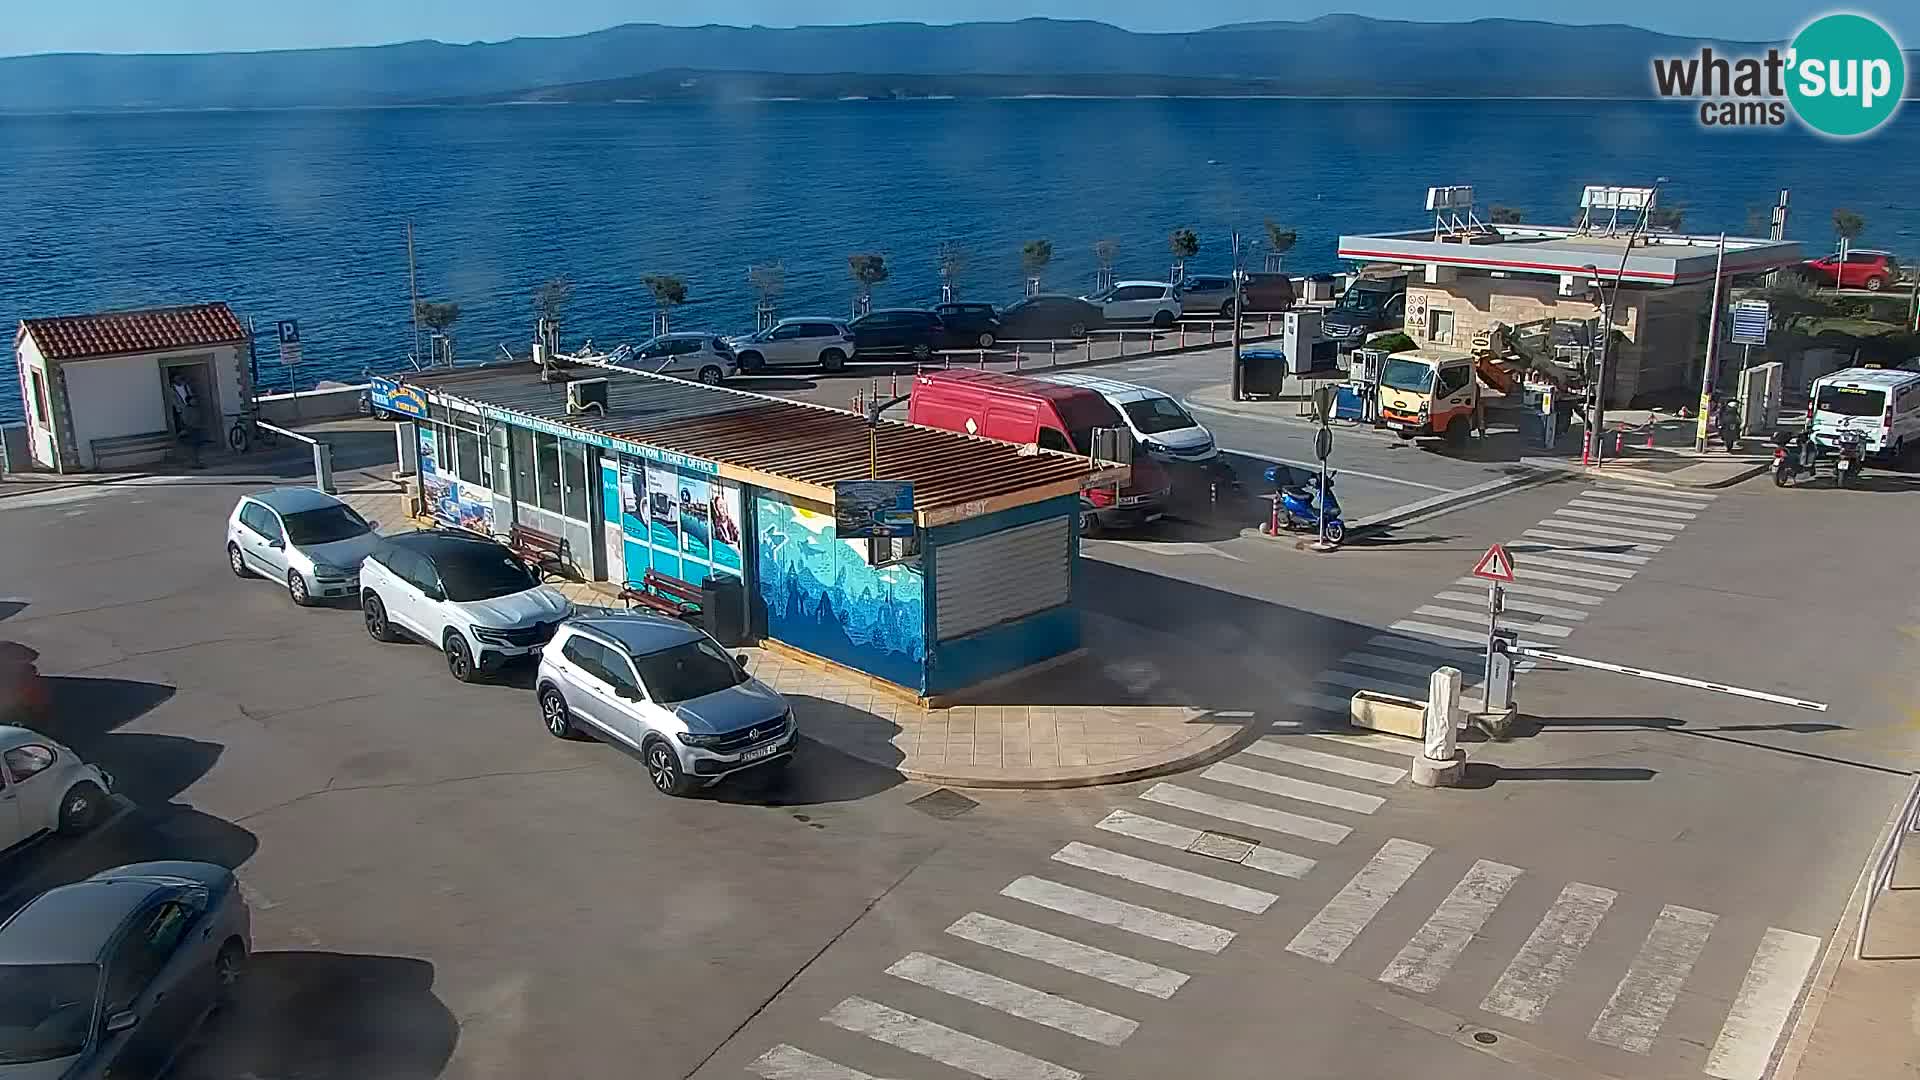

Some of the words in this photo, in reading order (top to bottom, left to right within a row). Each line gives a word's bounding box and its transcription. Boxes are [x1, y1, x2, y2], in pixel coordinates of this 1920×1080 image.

[283, 323, 295, 341] P
[572, 429, 602, 445] POSTAJA
[613, 440, 627, 452] BUS
[628, 443, 659, 459] STATION
[661, 449, 686, 465] TICKET
[687, 456, 713, 472] OFFICE
